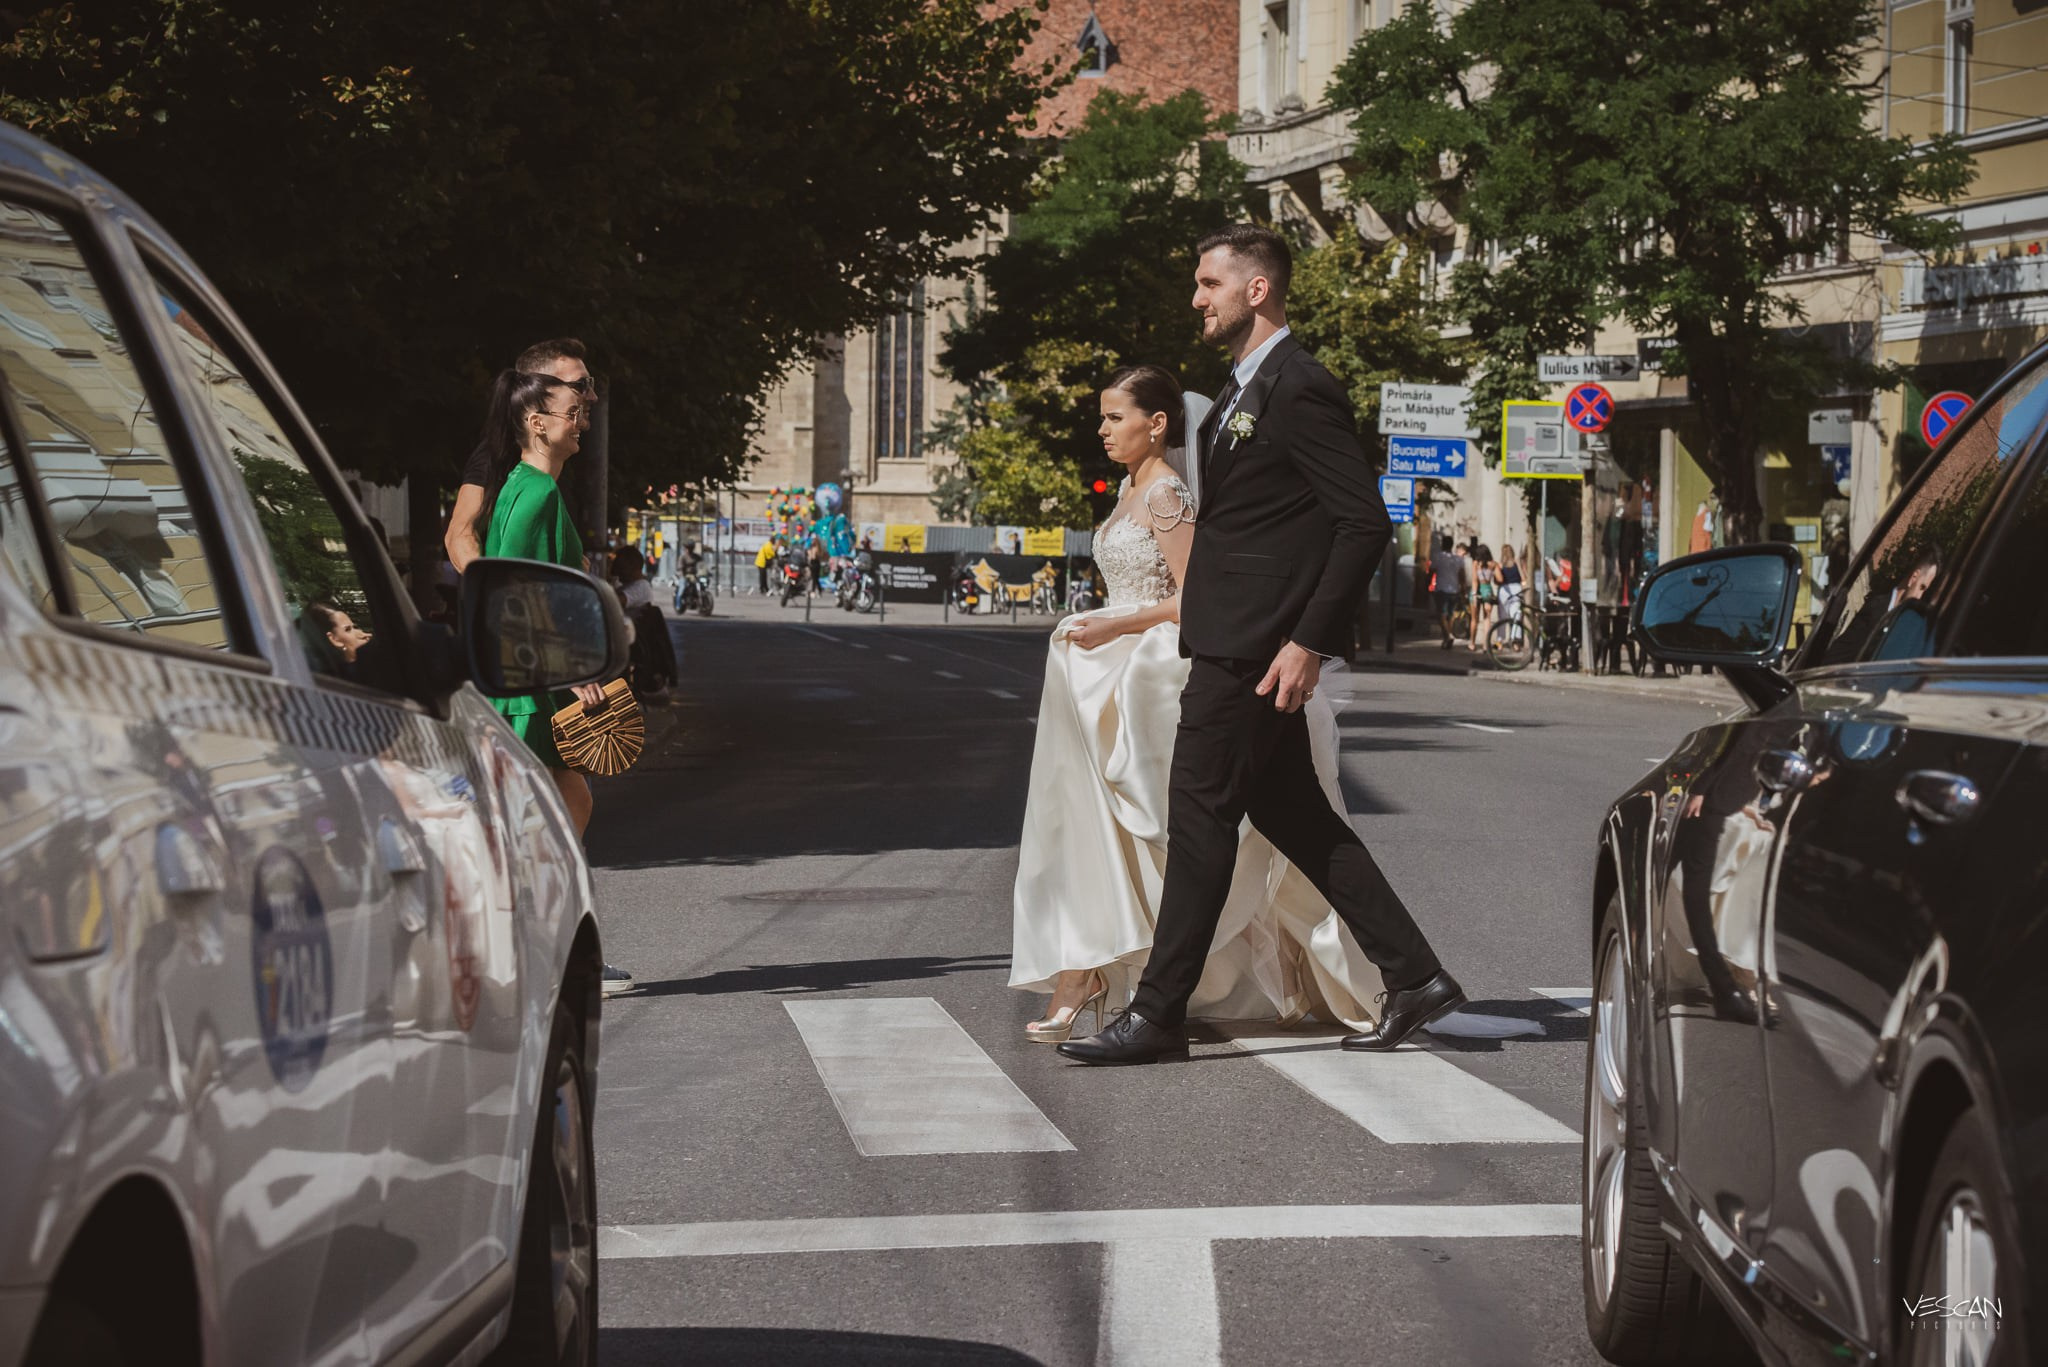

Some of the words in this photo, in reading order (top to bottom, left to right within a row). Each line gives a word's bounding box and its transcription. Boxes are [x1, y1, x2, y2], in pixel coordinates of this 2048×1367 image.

[1544, 361, 1579, 375] Iulius
[1583, 360, 1610, 375] Mall
[1387, 388, 1432, 401] Primăria
[1385, 418, 1427, 432] Parking
[1392, 442, 1438, 459] București
[1391, 458, 1414, 472] Satu
[1415, 459, 1441, 473] Mare
